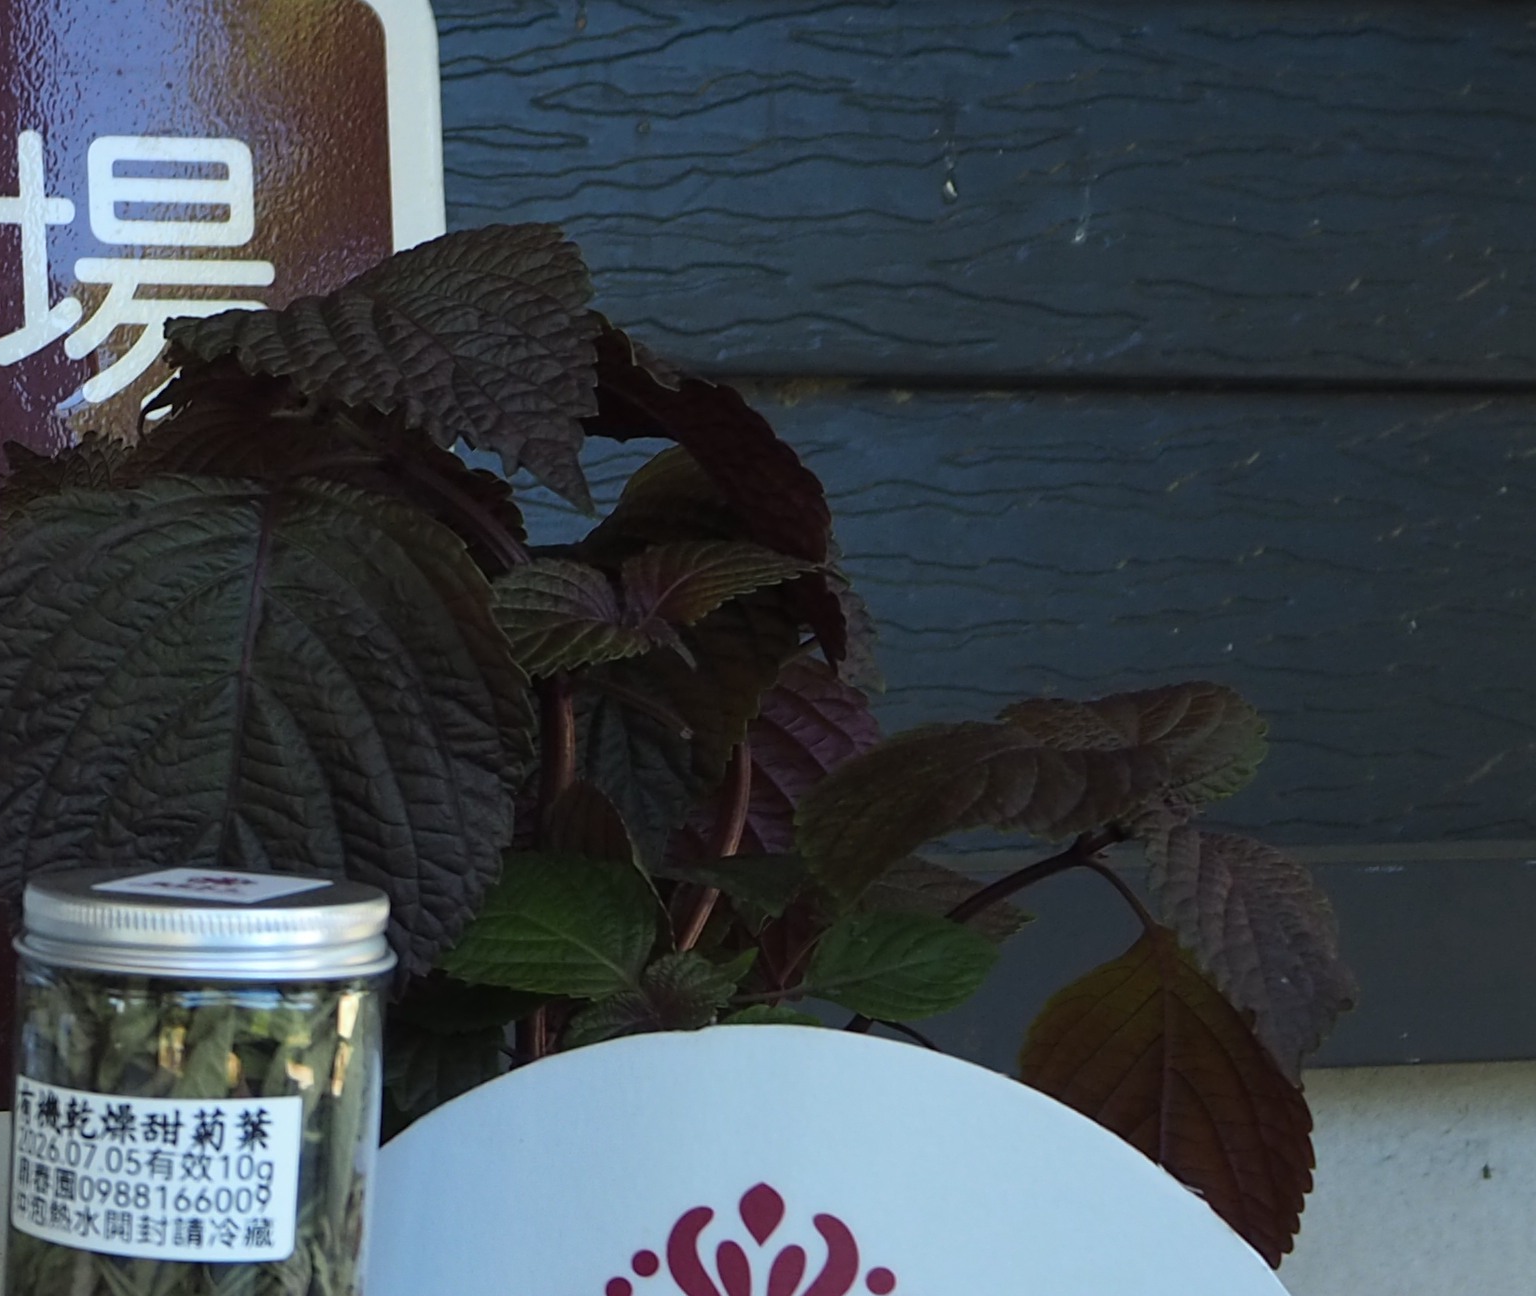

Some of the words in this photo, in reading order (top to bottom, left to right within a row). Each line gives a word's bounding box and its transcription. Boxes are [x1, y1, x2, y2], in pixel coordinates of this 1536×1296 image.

[18, 1083, 274, 1151] 有機乾燥甜菊葉
